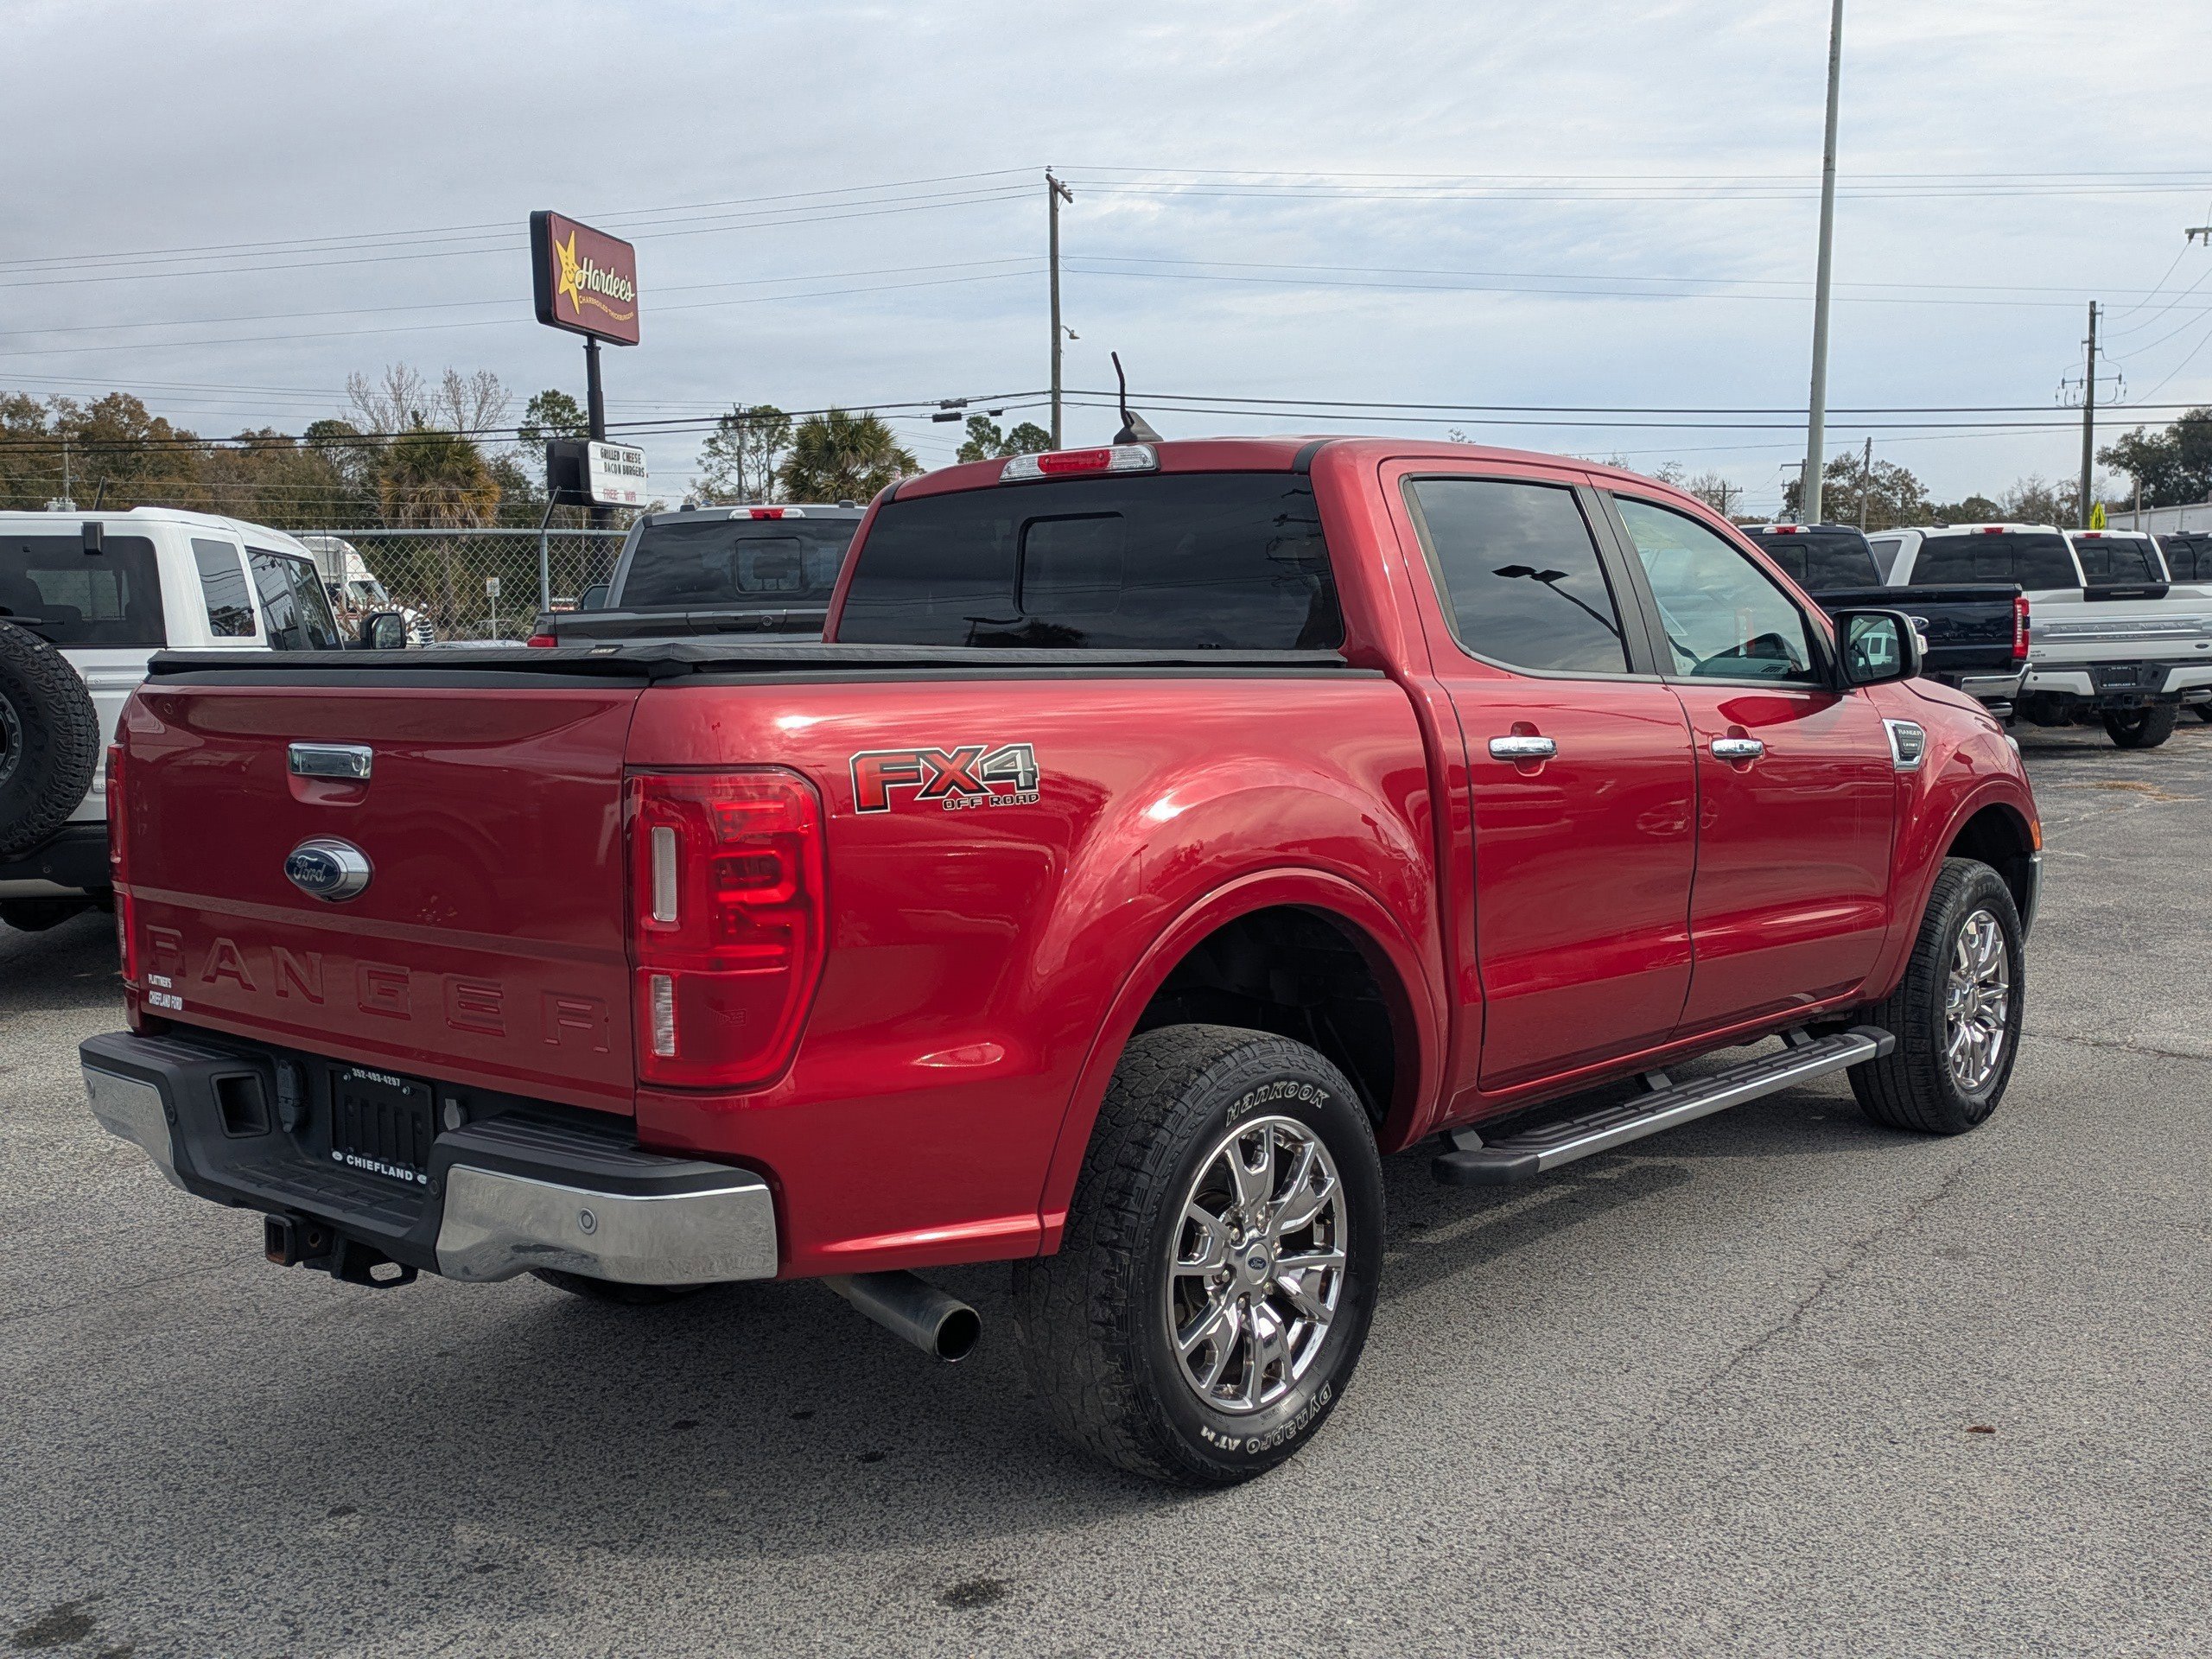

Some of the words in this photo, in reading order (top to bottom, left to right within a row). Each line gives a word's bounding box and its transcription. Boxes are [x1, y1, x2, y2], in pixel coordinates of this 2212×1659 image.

[575, 257, 635, 302] Hardee's
[601, 448, 620, 461] GRILLED
[622, 451, 641, 465] CHEESE
[604, 461, 621, 474] BACON
[622, 464, 645, 478] BURGERS
[849, 743, 1040, 815] FX4
[943, 797, 983, 811] OFF
[989, 792, 1040, 807] ROAD
[294, 855, 327, 882] Ford
[145, 924, 610, 1054] RANGER
[346, 1154, 414, 1181] CHIEFLAND
